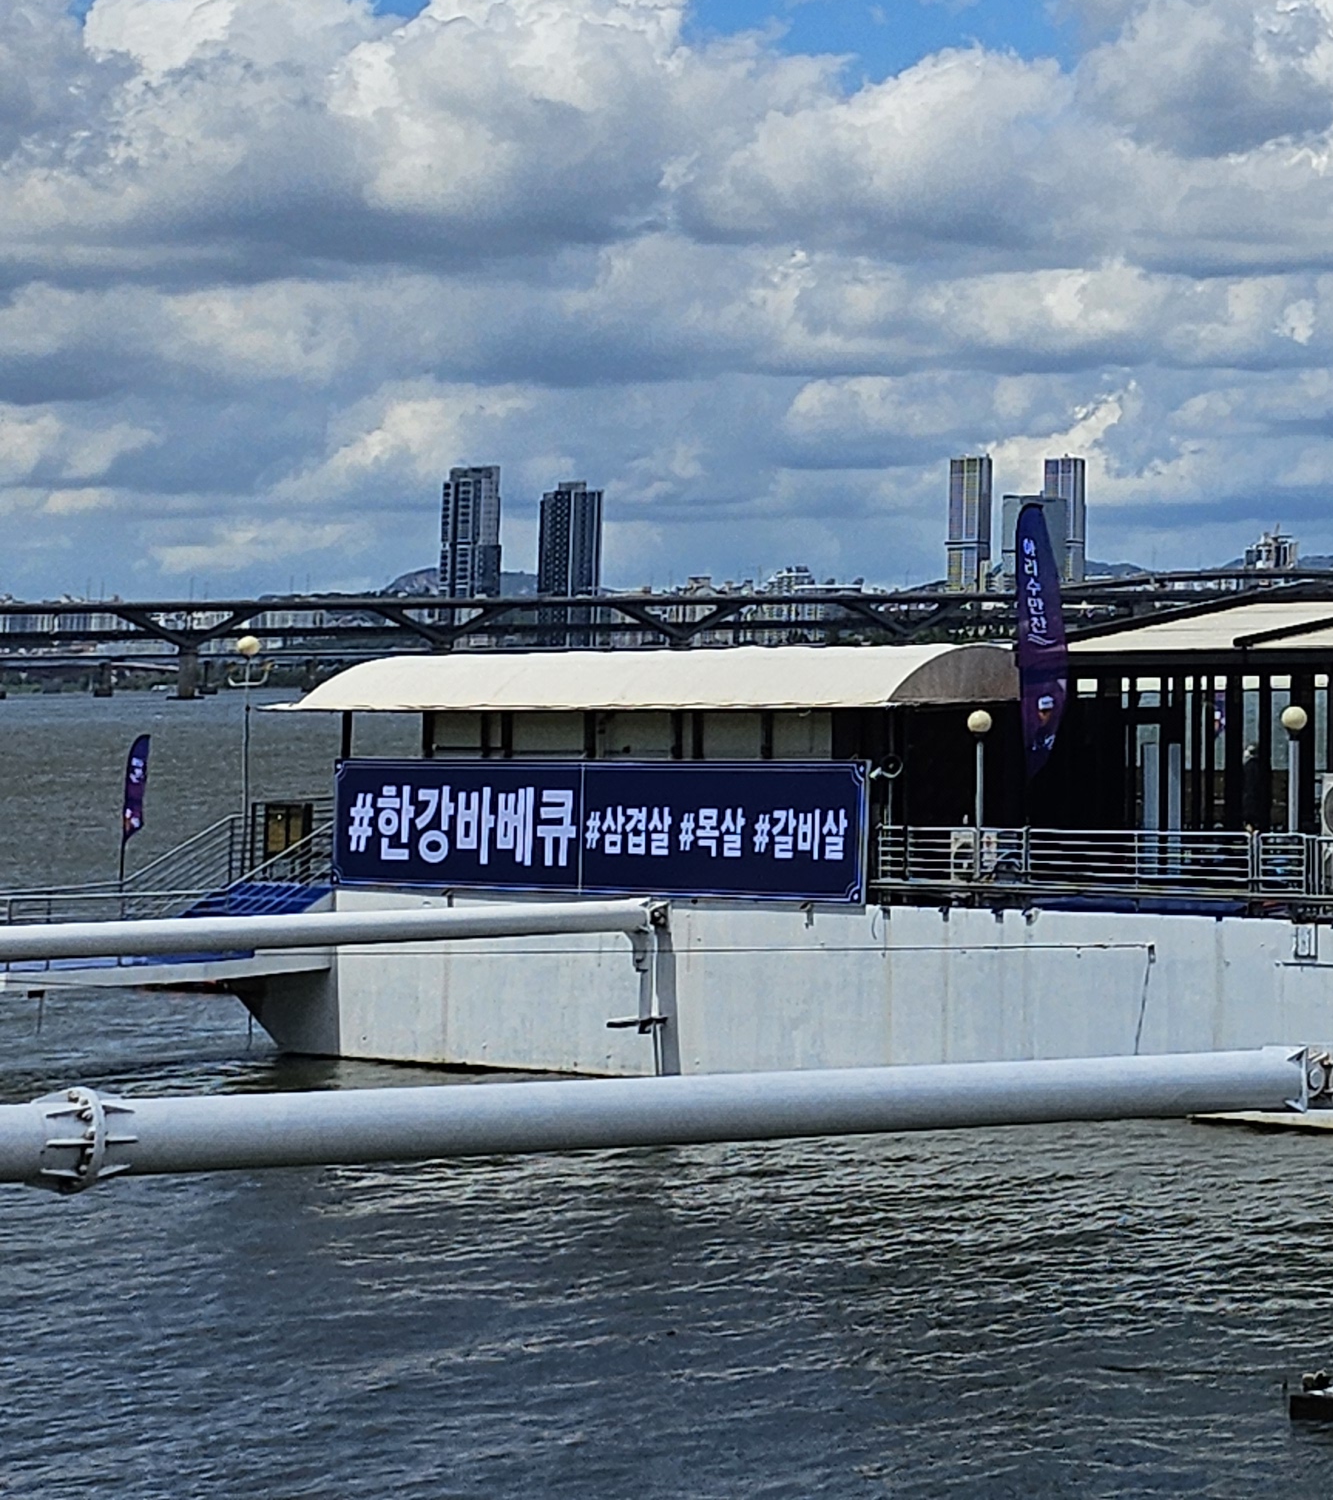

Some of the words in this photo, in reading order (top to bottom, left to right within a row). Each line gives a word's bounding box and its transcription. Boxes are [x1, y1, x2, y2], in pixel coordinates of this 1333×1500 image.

[348, 784, 577, 867] #한강바베큐
[585, 805, 673, 856] #삼겹살
[679, 806, 746, 858] #목살
[753, 807, 848, 861] #갈비살
